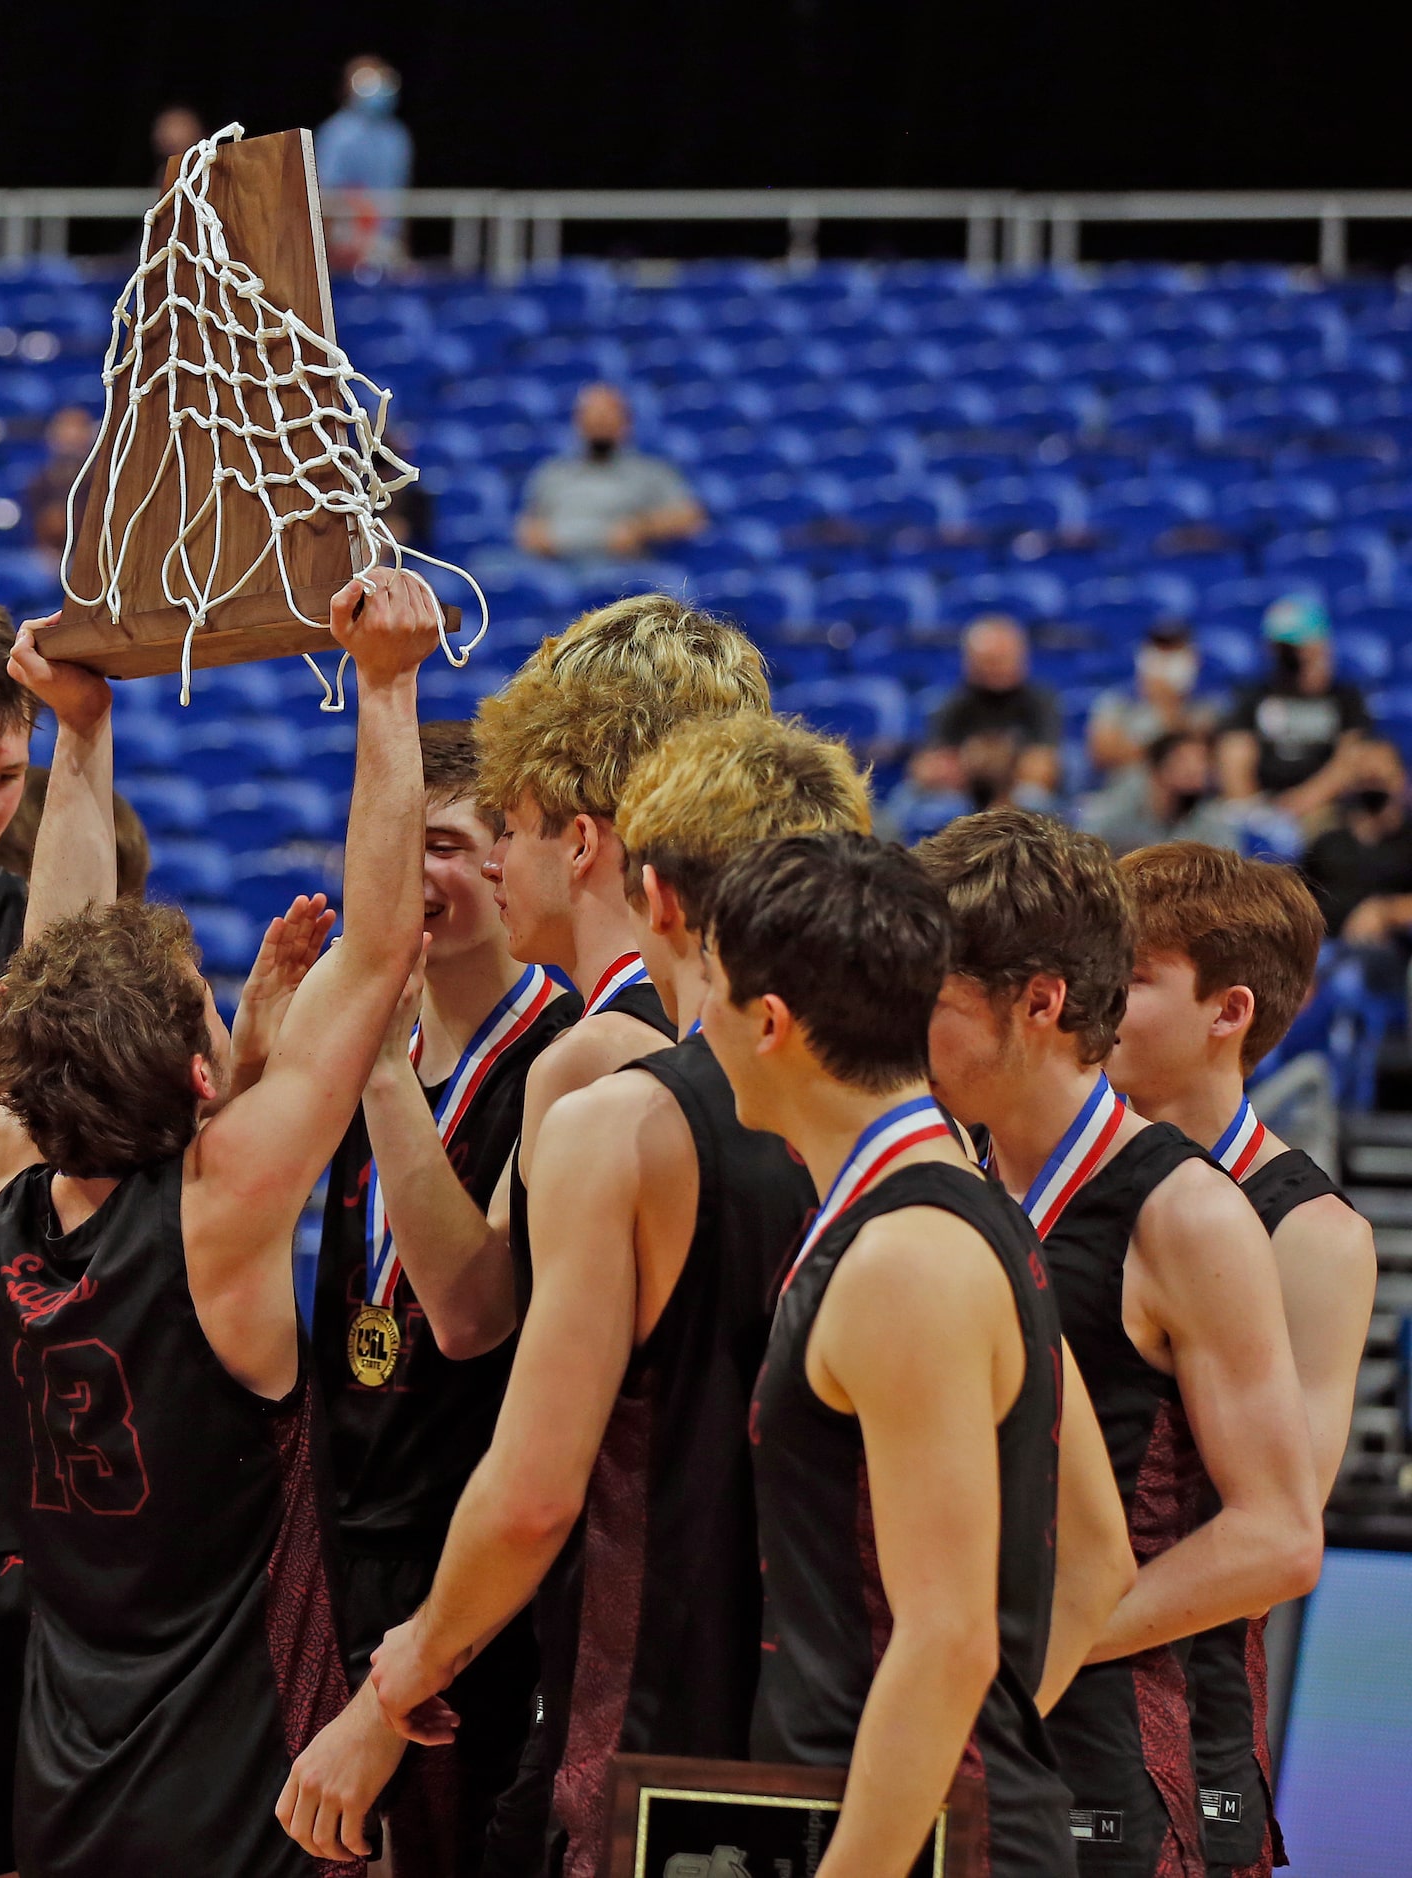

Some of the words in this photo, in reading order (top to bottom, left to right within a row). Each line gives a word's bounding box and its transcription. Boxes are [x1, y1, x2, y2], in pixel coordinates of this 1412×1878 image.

[361, 1359, 381, 1370] STATE
[12, 1337, 151, 1515] 13
[1225, 1800, 1236, 1814] M
[1101, 1819, 1114, 1834] M
